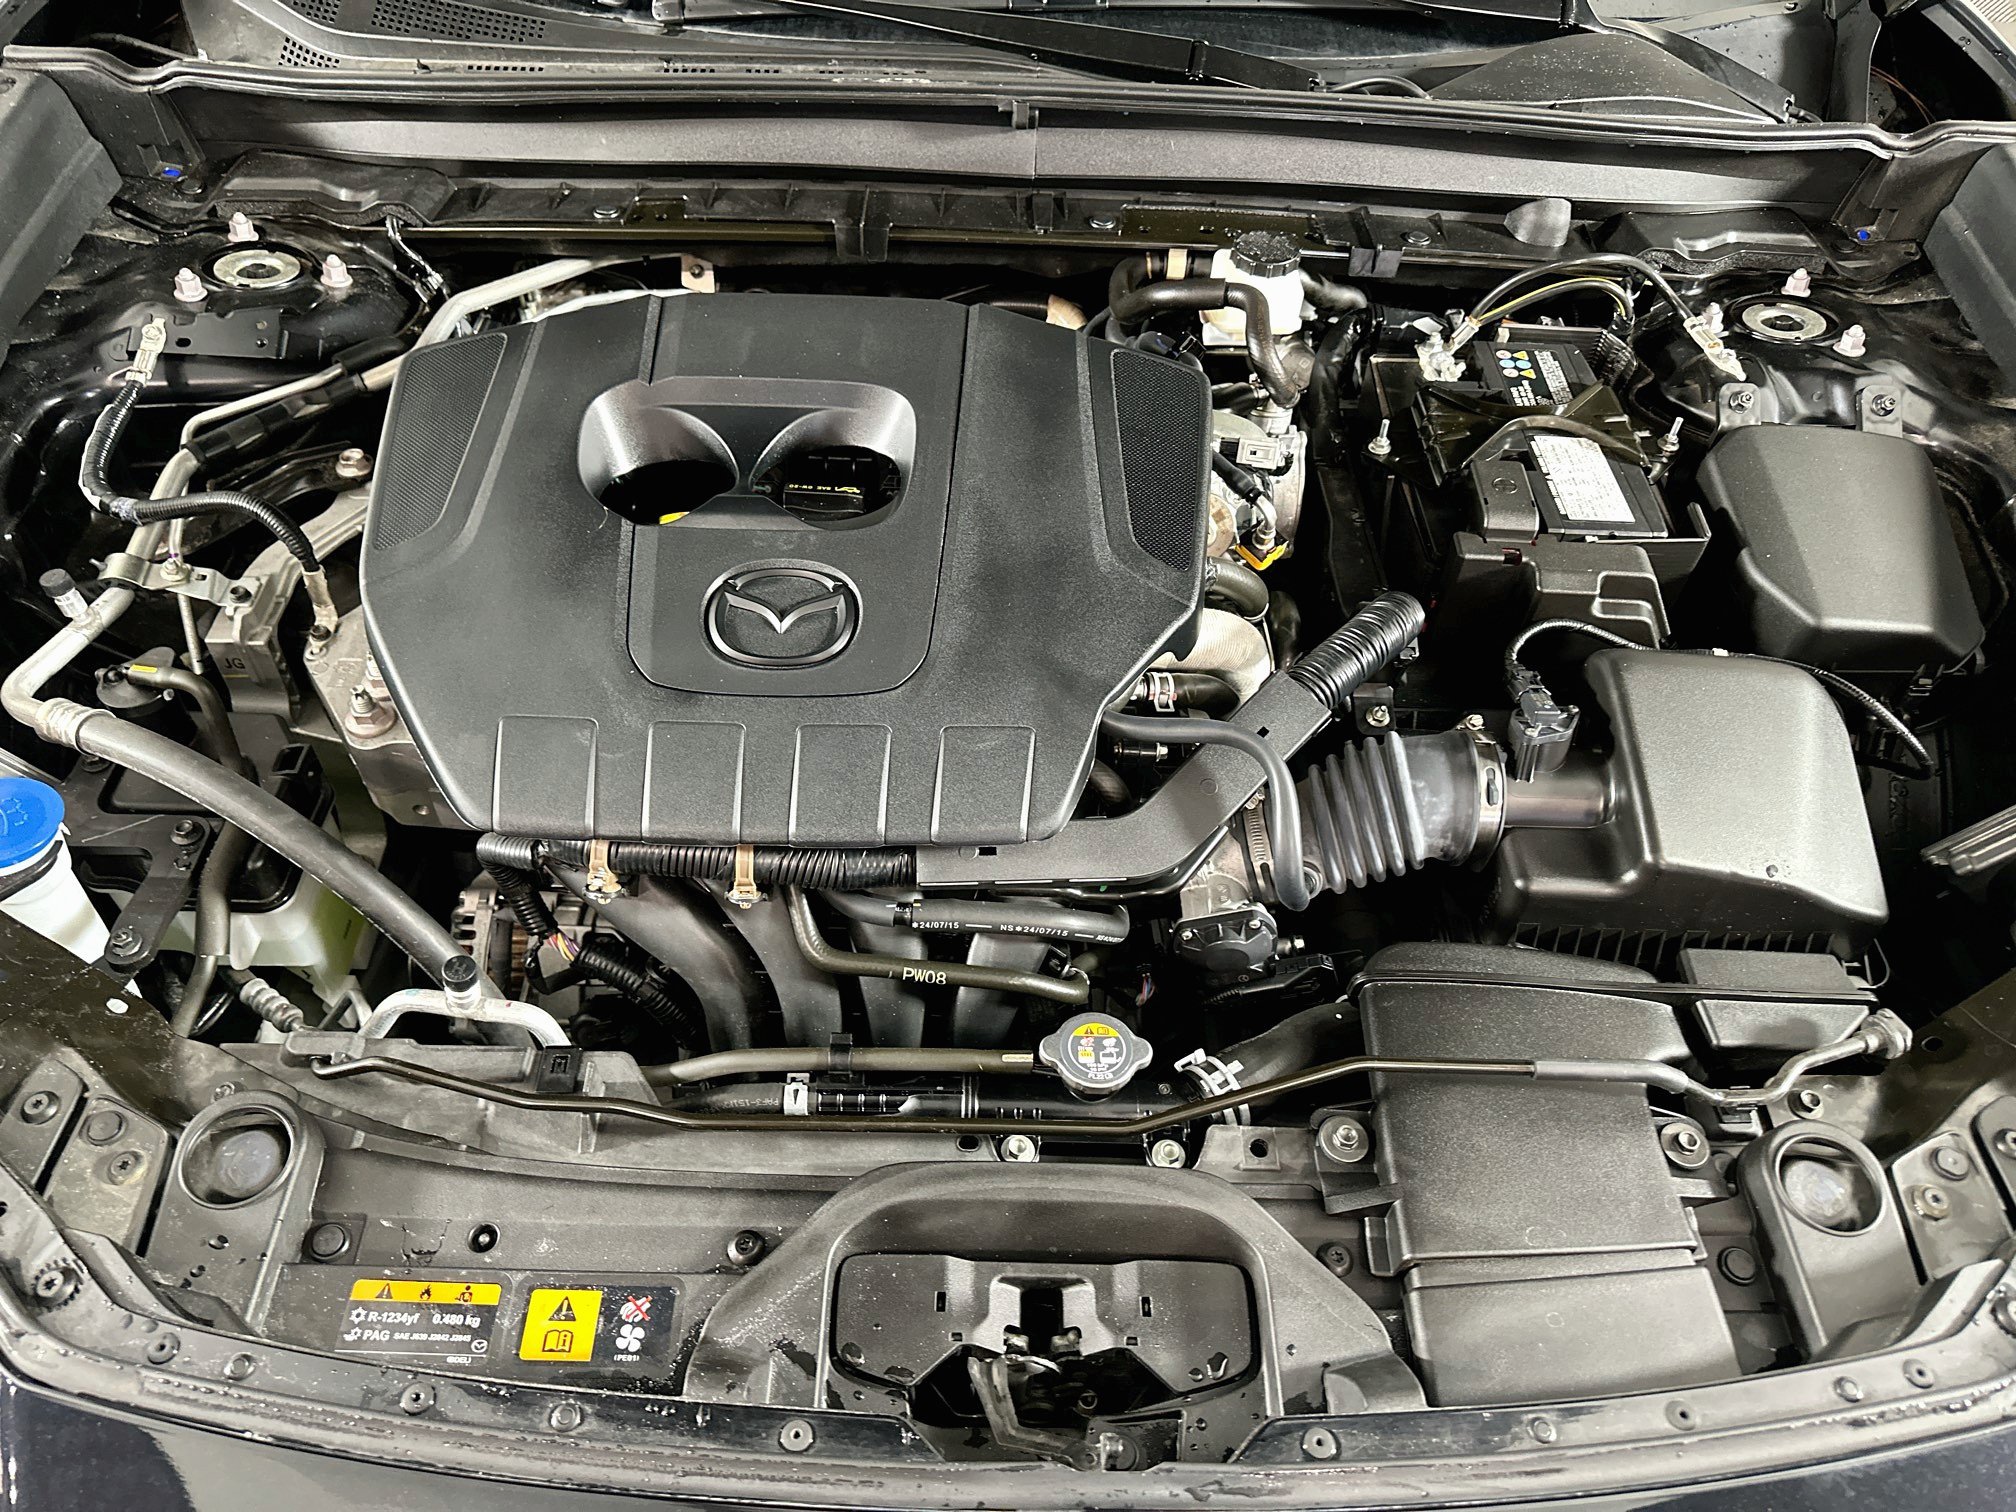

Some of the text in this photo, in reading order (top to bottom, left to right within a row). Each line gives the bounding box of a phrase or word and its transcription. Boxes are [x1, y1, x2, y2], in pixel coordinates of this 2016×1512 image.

[224, 657, 246, 669] JG
[902, 966, 947, 985] PW08
[367, 1311, 481, 1328] R-1234yf 0.480 kg
[362, 1329, 391, 1341] PAG
[393, 1332, 410, 1340] SAE
